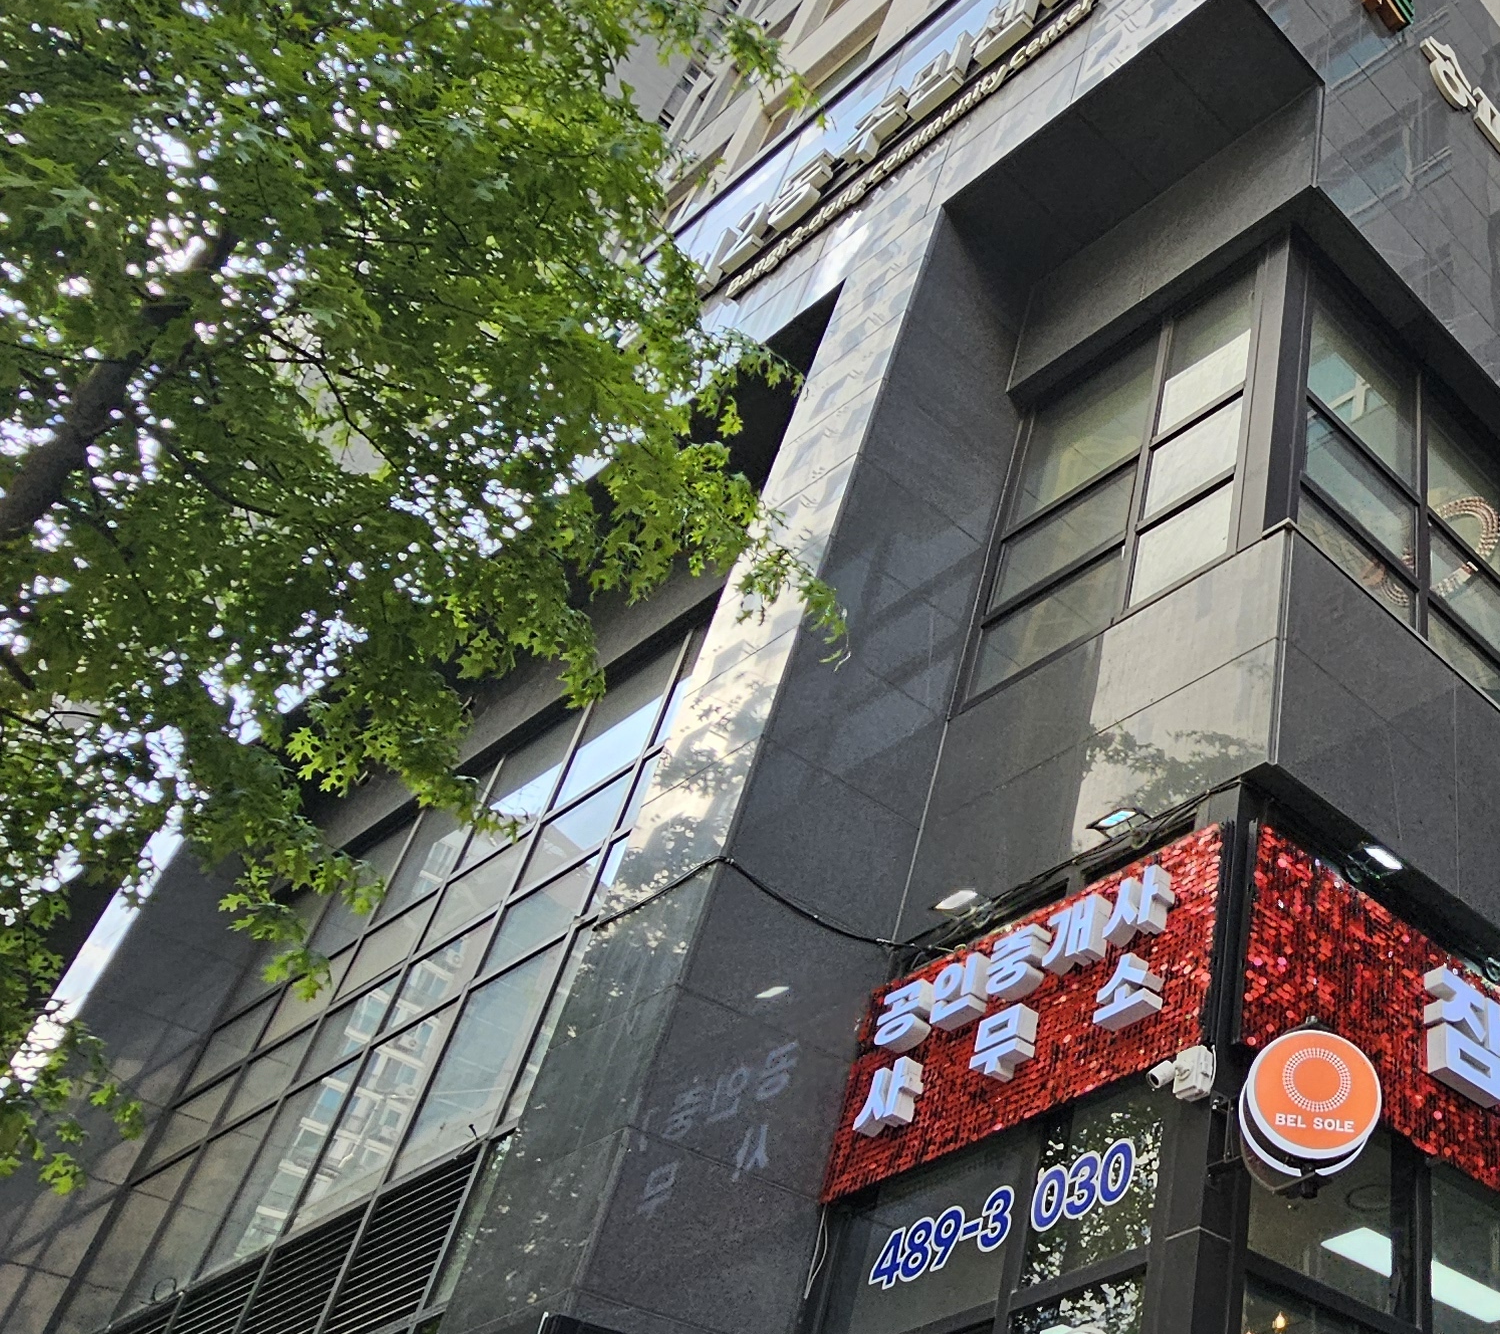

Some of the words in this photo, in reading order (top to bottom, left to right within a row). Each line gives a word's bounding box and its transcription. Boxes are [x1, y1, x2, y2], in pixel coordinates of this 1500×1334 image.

[873, 864, 1176, 1052] 공인중개사
[1274, 1111, 1307, 1129] BEL
[1312, 1116, 1355, 1134] SOLE
